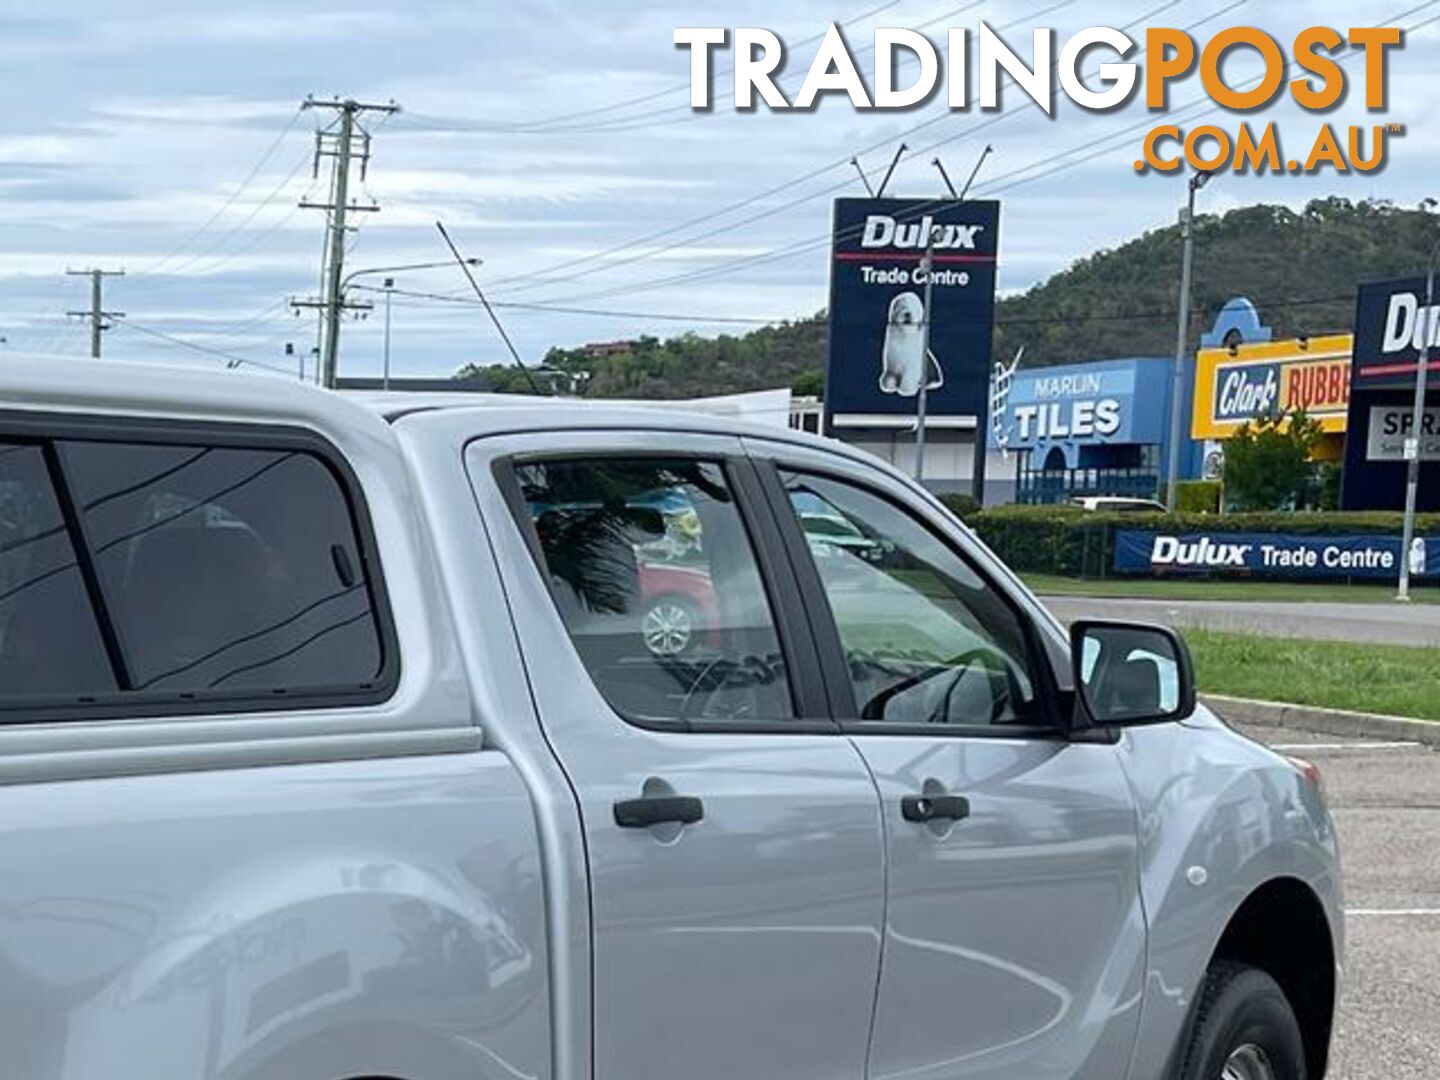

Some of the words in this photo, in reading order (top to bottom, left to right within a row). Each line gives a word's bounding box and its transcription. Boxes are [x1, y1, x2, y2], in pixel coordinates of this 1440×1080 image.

[861, 267, 909, 284] Trade
[1034, 373, 1101, 398] MARLIN
[1219, 367, 1276, 416] Clark
[1015, 400, 1120, 440] TILES
[1383, 412, 1440, 436] SPR
[1152, 536, 1247, 566] Dulux
[1261, 545, 1317, 567] Trade
[1323, 546, 1393, 568] Centre
